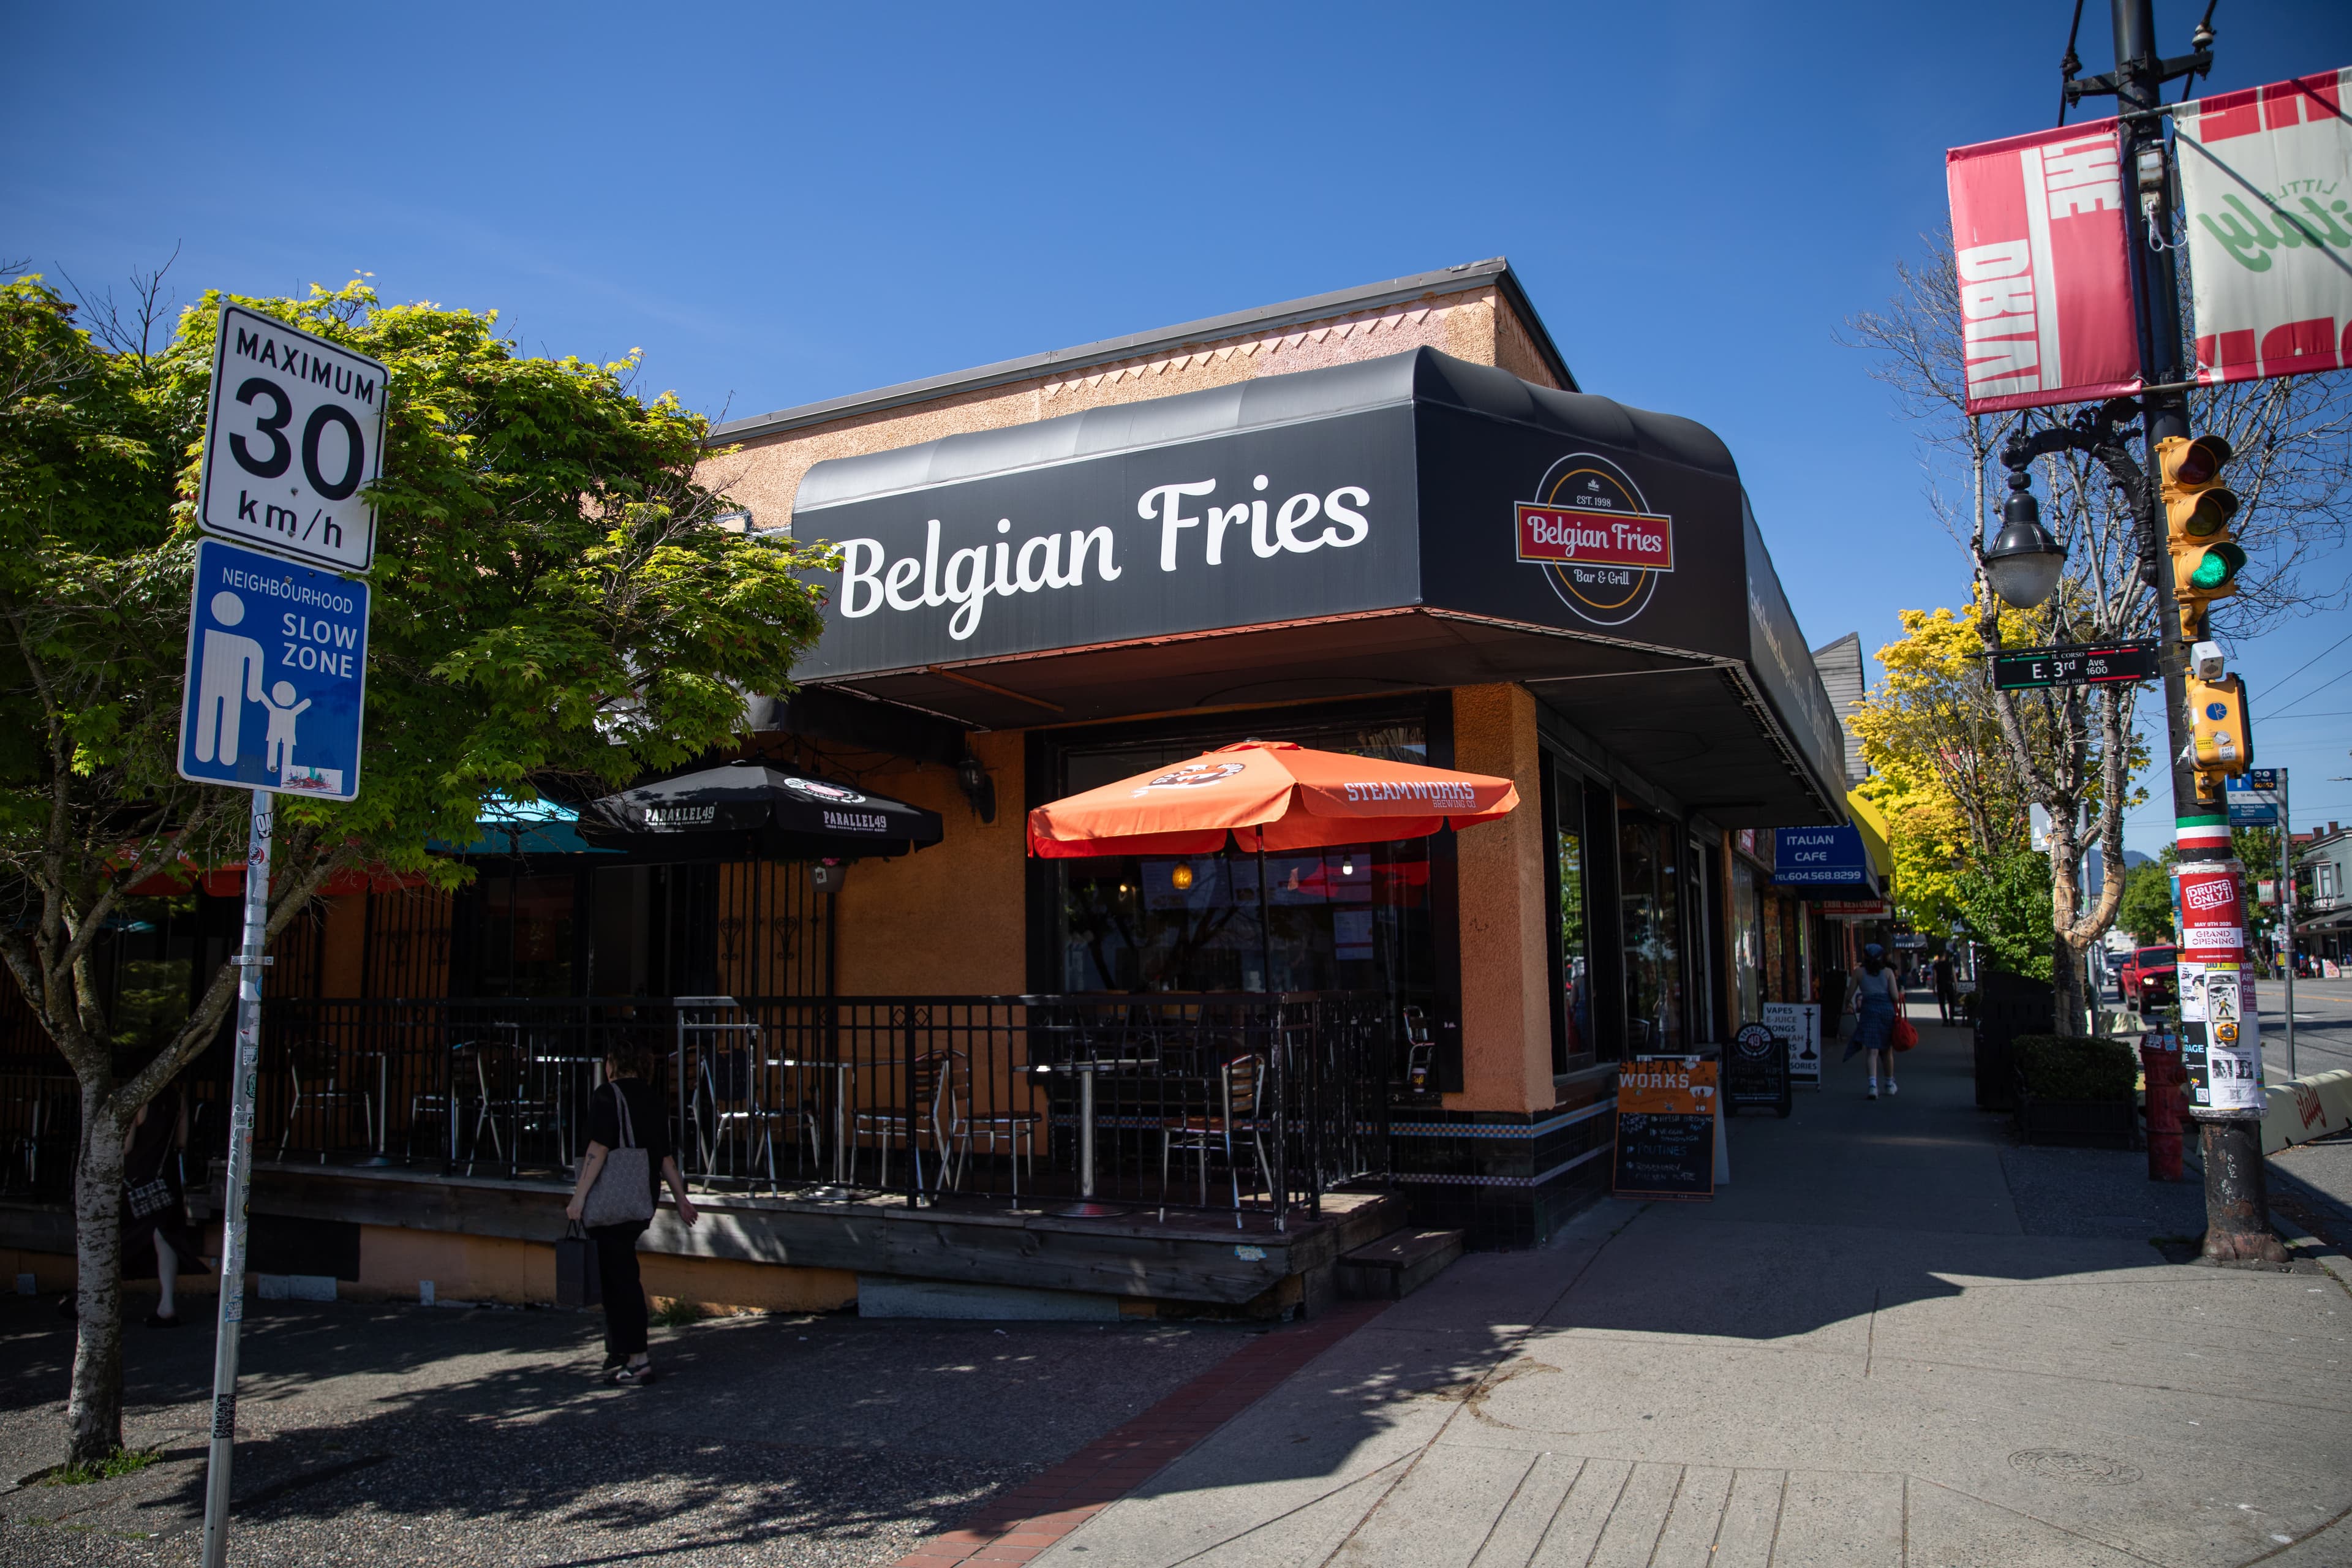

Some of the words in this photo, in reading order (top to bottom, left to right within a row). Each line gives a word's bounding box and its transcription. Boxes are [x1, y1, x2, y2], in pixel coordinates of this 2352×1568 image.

[236, 327, 375, 405] MAXIMUM
[229, 377, 364, 501] 30
[1577, 495, 1593, 505] EST.
[1594, 497, 1611, 507] 1998
[238, 489, 342, 549] km/h
[1527, 516, 1609, 557] Belgian
[1611, 523, 1662, 552] Fries
[826, 518, 1121, 640] Belgian
[1138, 474, 1370, 573] Fries
[1574, 569, 1595, 582] Bar
[1598, 571, 1606, 583] &
[1608, 571, 1629, 585] Grill
[223, 567, 353, 614] NEIGHBOURHOOD
[282, 613, 357, 650] SLOW
[282, 643, 353, 679] ZONE
[2032, 663, 2048, 679] E.
[2054, 660, 2076, 677] 3rd
[2086, 666, 2108, 675] 1600
[1343, 782, 1475, 802] STEAMWORKS
[1432, 799, 1465, 809] BREWING
[1787, 835, 1834, 846] ITALIAN
[1795, 851, 1828, 862] CAFE
[2188, 882, 2228, 897] DRUMS
[2192, 891, 2230, 905] ONLY!
[1619, 1060, 1688, 1074] STEAM
[1619, 1073, 1690, 1088] WORKS
